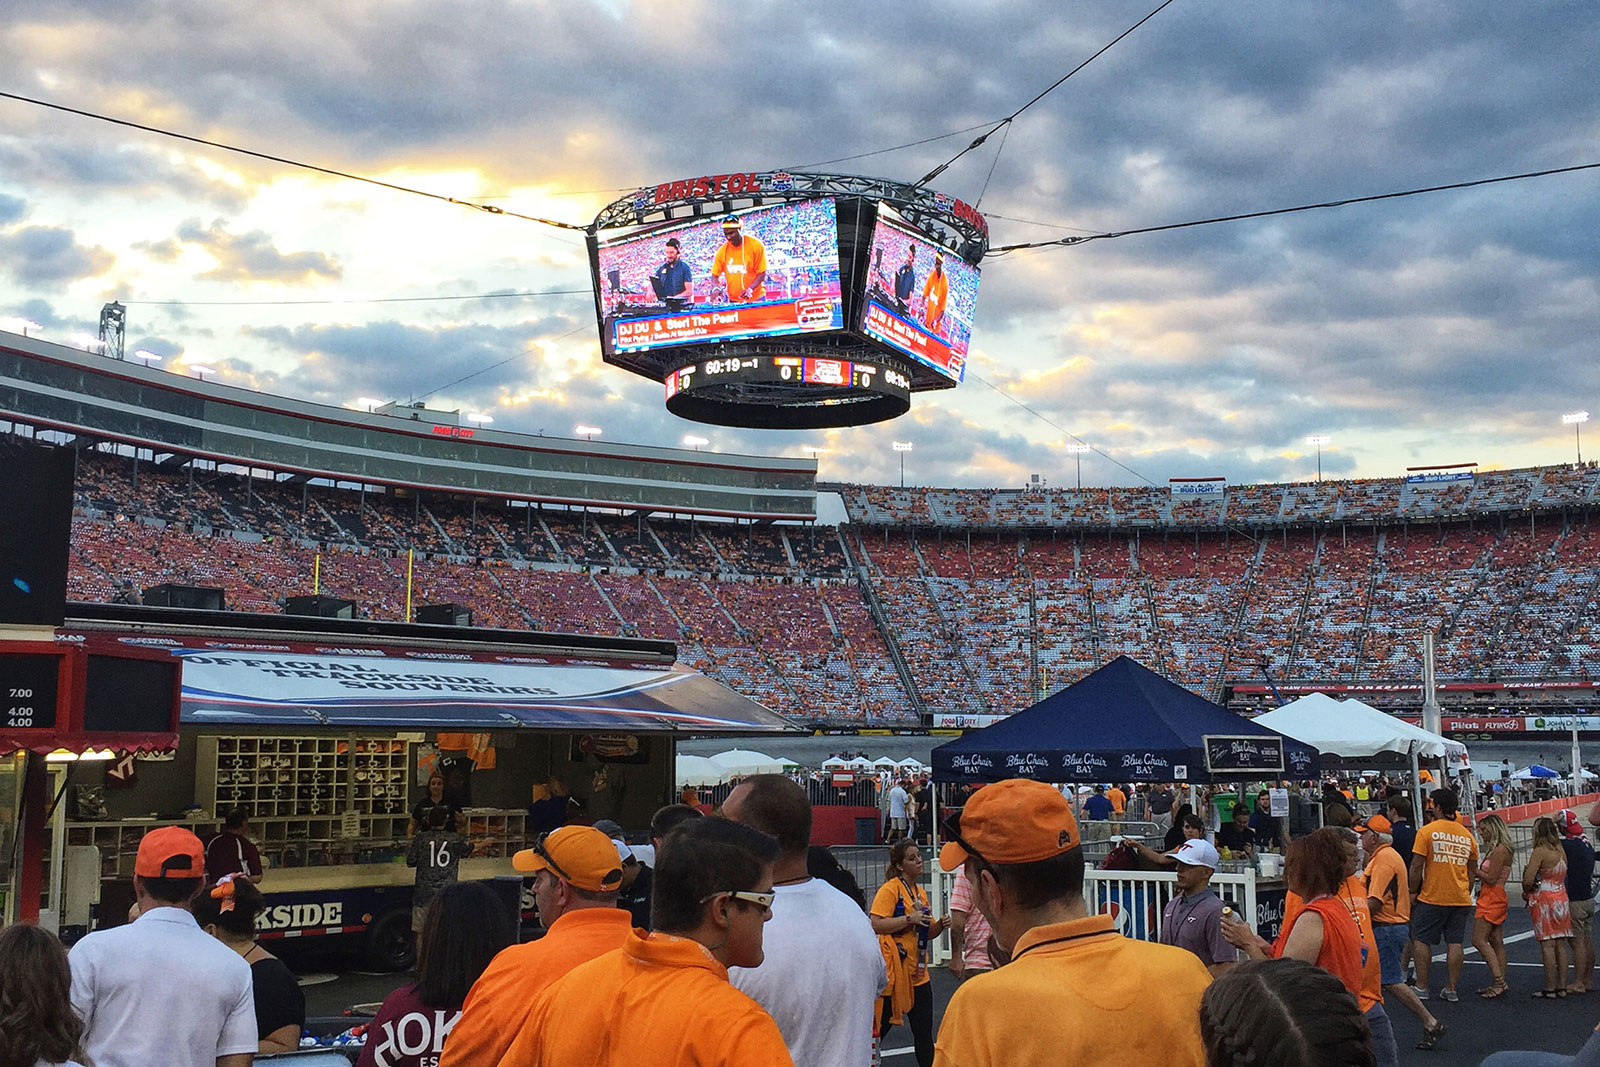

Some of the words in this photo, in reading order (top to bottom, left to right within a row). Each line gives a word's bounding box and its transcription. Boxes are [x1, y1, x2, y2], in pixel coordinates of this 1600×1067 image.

[655, 172, 762, 203] BRISTOL
[620, 325, 632, 335] DJ
[634, 323, 649, 333] DU
[654, 321, 663, 331] &
[691, 316, 710, 326] The
[712, 312, 739, 324] Pearl
[781, 366, 791, 380] 0
[862, 374, 870, 388] 0
[183, 655, 380, 672] OFFICIAL
[261, 668, 495, 685] TRACKSIDE
[9, 689, 33, 698] 7.00
[339, 680, 558, 695] SOUVENIRS
[8, 707, 33, 716] 4.00
[7, 718, 33, 727] 4.00
[1451, 722, 1479, 730] Pilot
[952, 755, 971, 768] Blue
[972, 754, 993, 767] Chair
[1006, 754, 1025, 767] Blue
[1026, 753, 1049, 766] Chair
[1062, 753, 1082, 767] Blue
[1084, 753, 1107, 767] Chair
[1122, 754, 1142, 767] Blue
[1144, 753, 1168, 767] Chair
[1136, 766, 1154, 774] BAY
[1432, 832, 1471, 846] ORANGE
[429, 840, 450, 867] 16
[1438, 842, 1467, 856] LIVES
[1256, 901, 1278, 925] Blue
